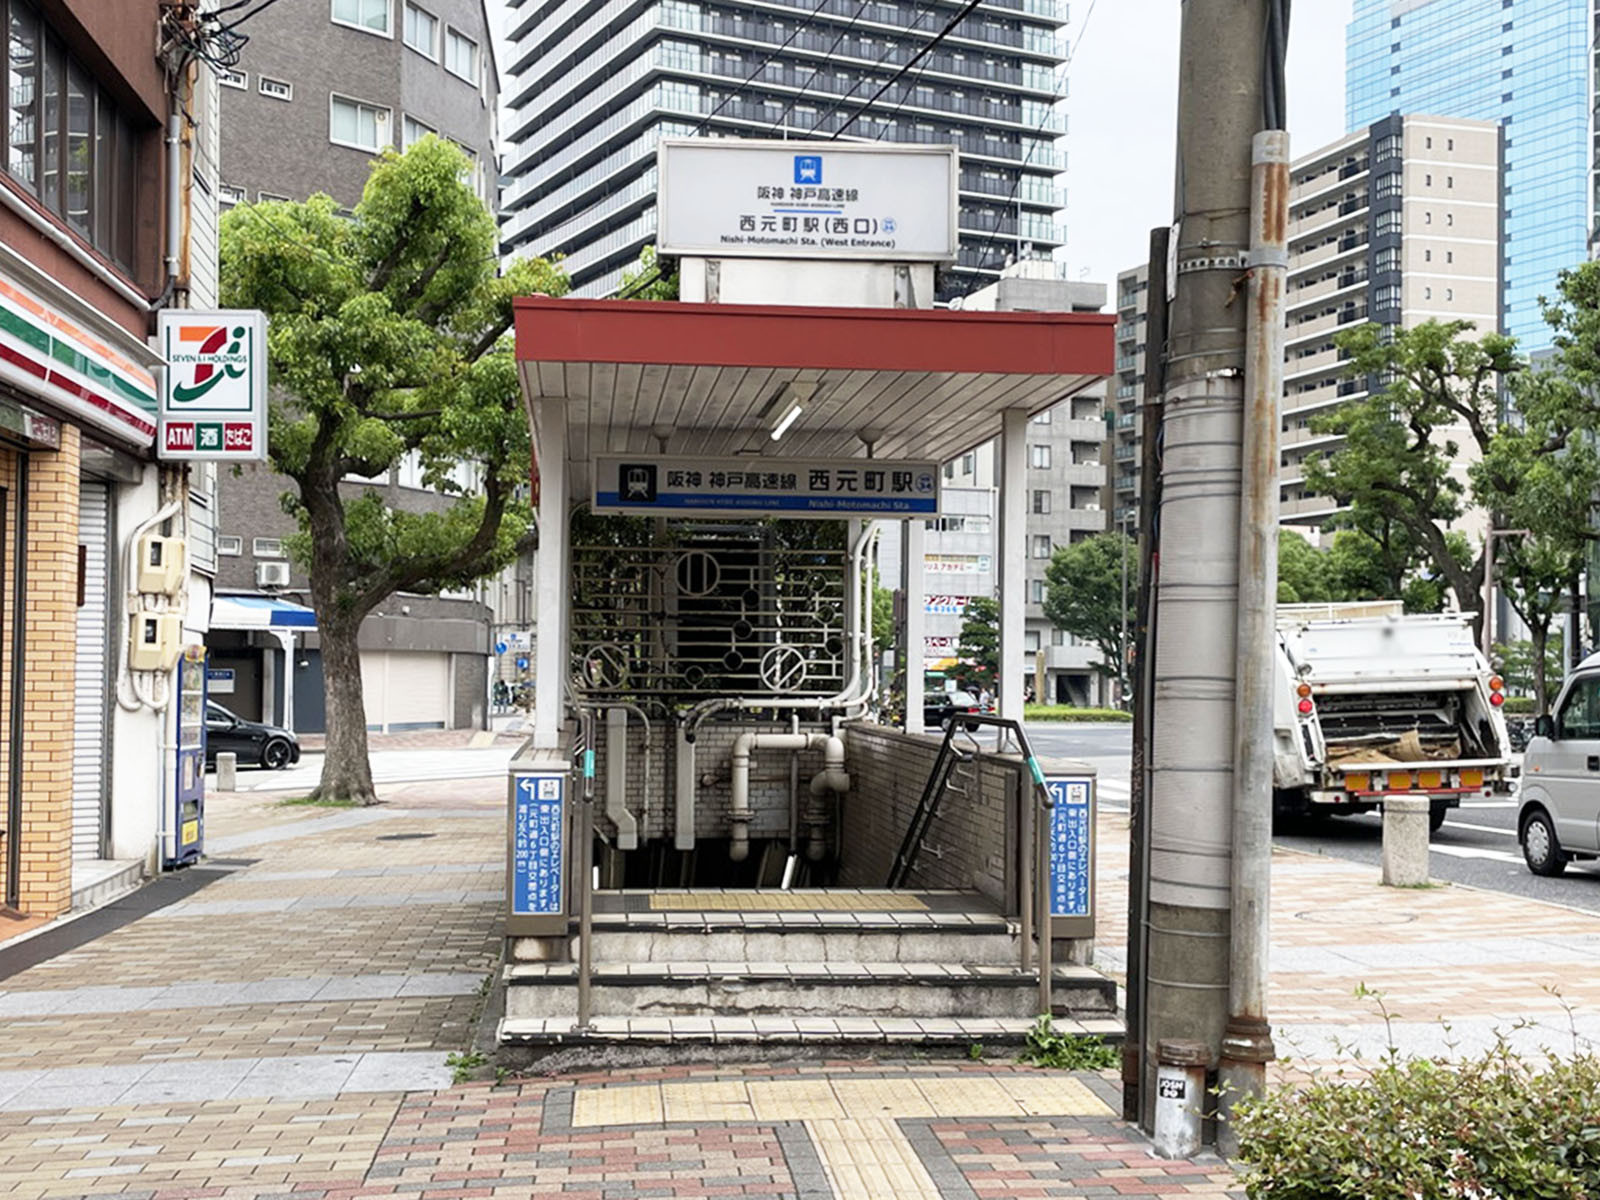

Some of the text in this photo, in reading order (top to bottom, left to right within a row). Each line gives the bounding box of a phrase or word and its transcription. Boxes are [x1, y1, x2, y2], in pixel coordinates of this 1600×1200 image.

[757, 186, 859, 202] 阪神 神戸高速線
[739, 214, 878, 235] 西元町駅(西口)
[720, 235, 896, 249] Nishi-Motomachi Sta. (West Entrance)
[172, 354, 196, 363] SEVEN
[207, 354, 247, 364] HOLDINGS
[168, 427, 252, 446] ATM 酒 たばこ
[667, 469, 913, 493] 阪神 神戸高速線 西元町駅
